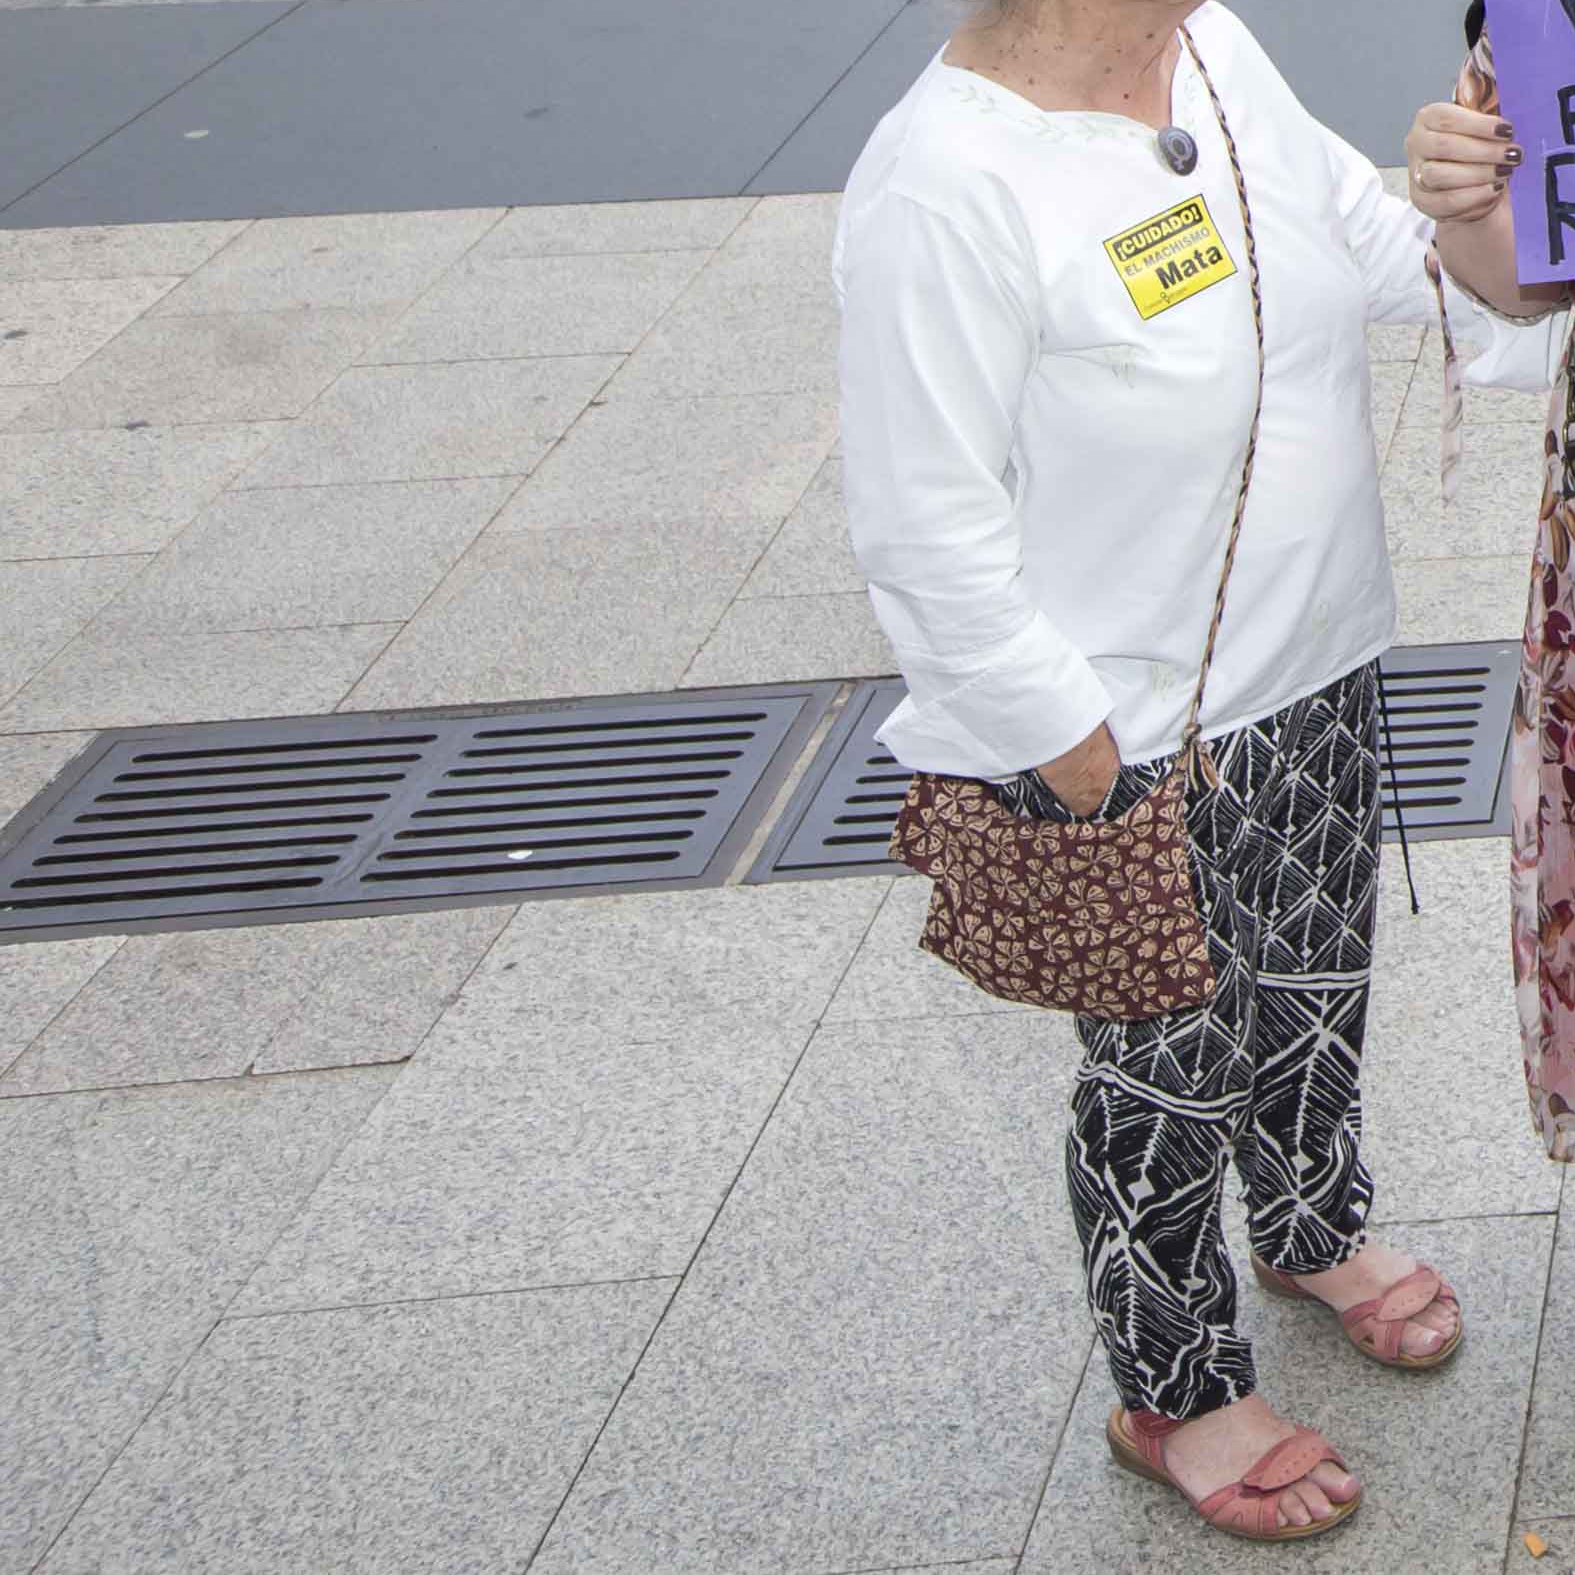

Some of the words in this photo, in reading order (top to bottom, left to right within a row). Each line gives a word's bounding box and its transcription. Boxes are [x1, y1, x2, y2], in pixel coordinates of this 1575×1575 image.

[1117, 205, 1201, 261] ¡CUIDADO!
[1125, 262, 1143, 277] EL
[1144, 226, 1211, 267] MACHISMO
[1155, 244, 1224, 290] Mata
